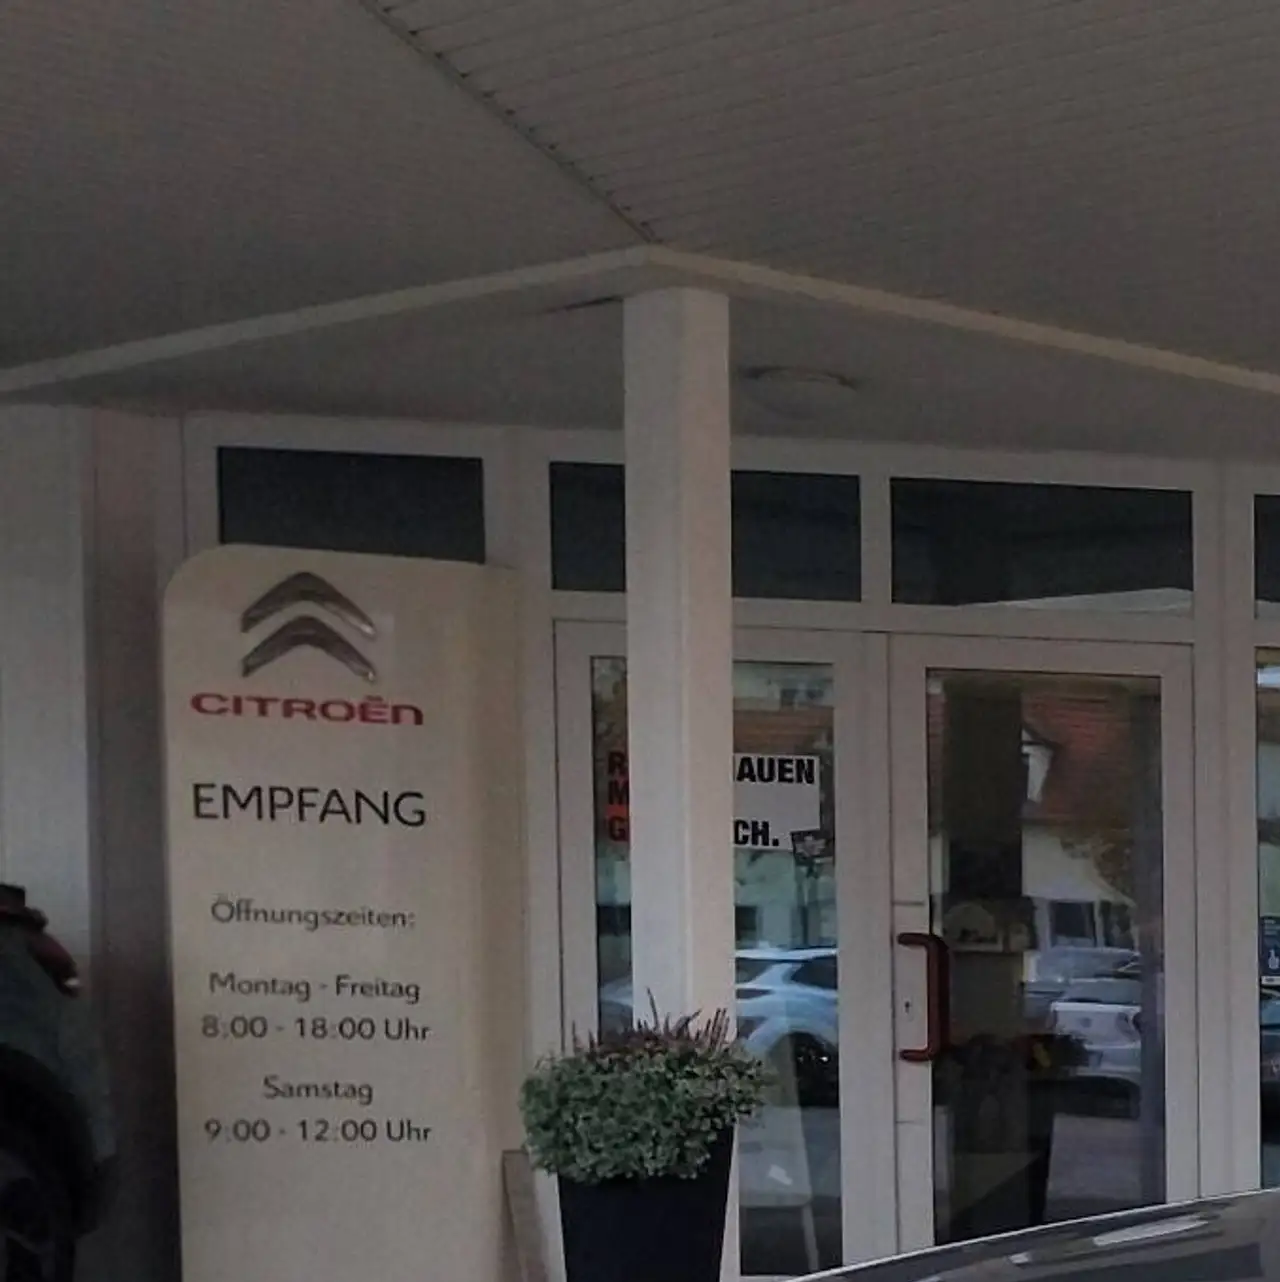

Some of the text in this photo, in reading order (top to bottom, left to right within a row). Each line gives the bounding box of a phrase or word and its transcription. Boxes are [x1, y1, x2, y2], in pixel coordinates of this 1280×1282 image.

[735, 756, 815, 784] AUEN
[192, 783, 427, 827] EMPFANG
[733, 819, 780, 846] CH.
[210, 894, 417, 932] Öffnungszeiten:
[209, 972, 311, 1003] Montag
[335, 974, 421, 1005] Freitag
[201, 1015, 268, 1039] 8:00
[296, 1016, 376, 1041] 18:00
[384, 1018, 431, 1042] Uhr
[262, 1075, 374, 1106] Samstag
[203, 1119, 271, 1143] 9:00
[299, 1119, 378, 1144] 12:00
[386, 1120, 432, 1144] Uhr
